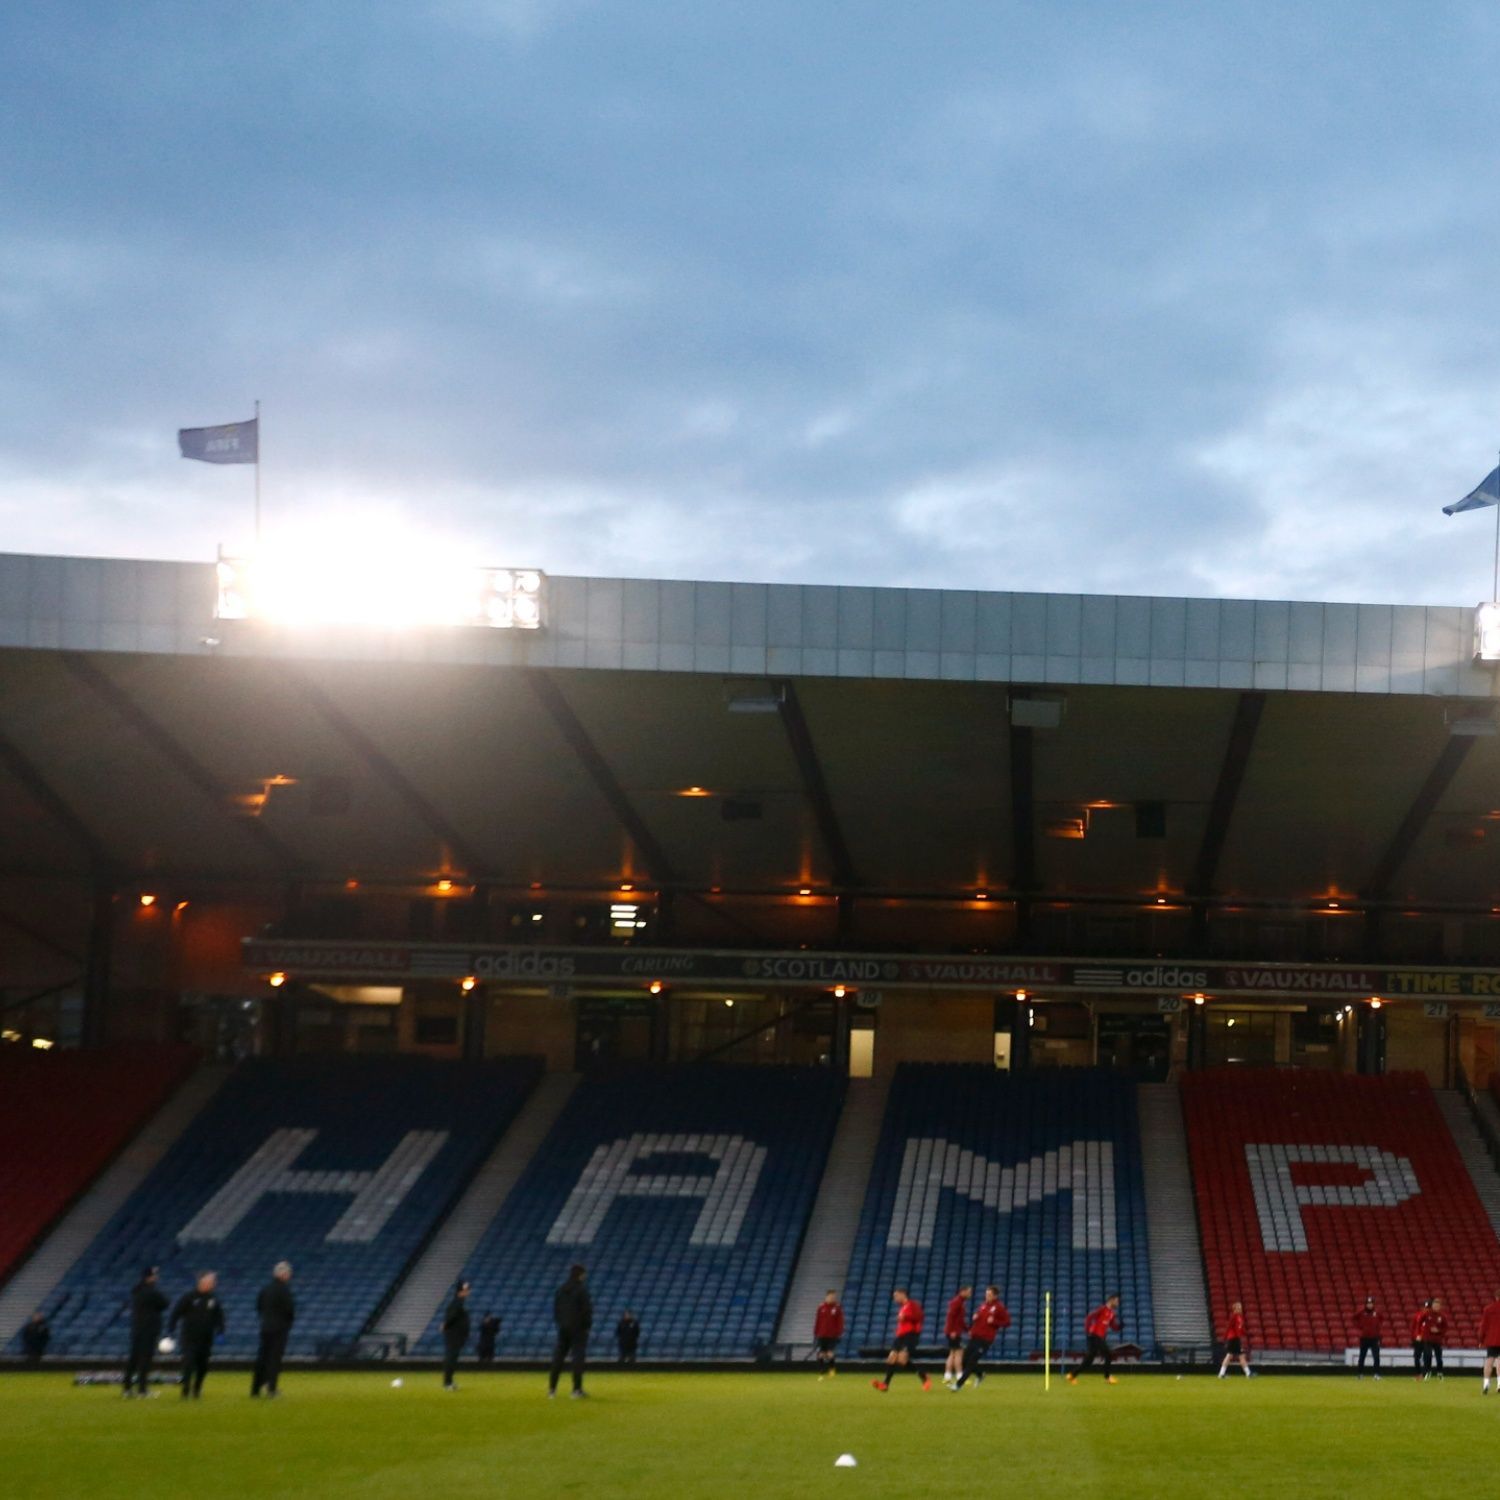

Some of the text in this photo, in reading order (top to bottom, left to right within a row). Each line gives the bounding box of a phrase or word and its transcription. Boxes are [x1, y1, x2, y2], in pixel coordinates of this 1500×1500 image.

[474, 949, 575, 976] adidas
[621, 953, 694, 973] CARLING
[761, 957, 880, 979] SCOTLAND
[924, 963, 1055, 981] VAUXHALL
[1126, 966, 1208, 987] adidas
[1242, 970, 1373, 990] VAUXHALL
[1400, 973, 1461, 993] TIME
[1160, 998, 1181, 1011] 20
